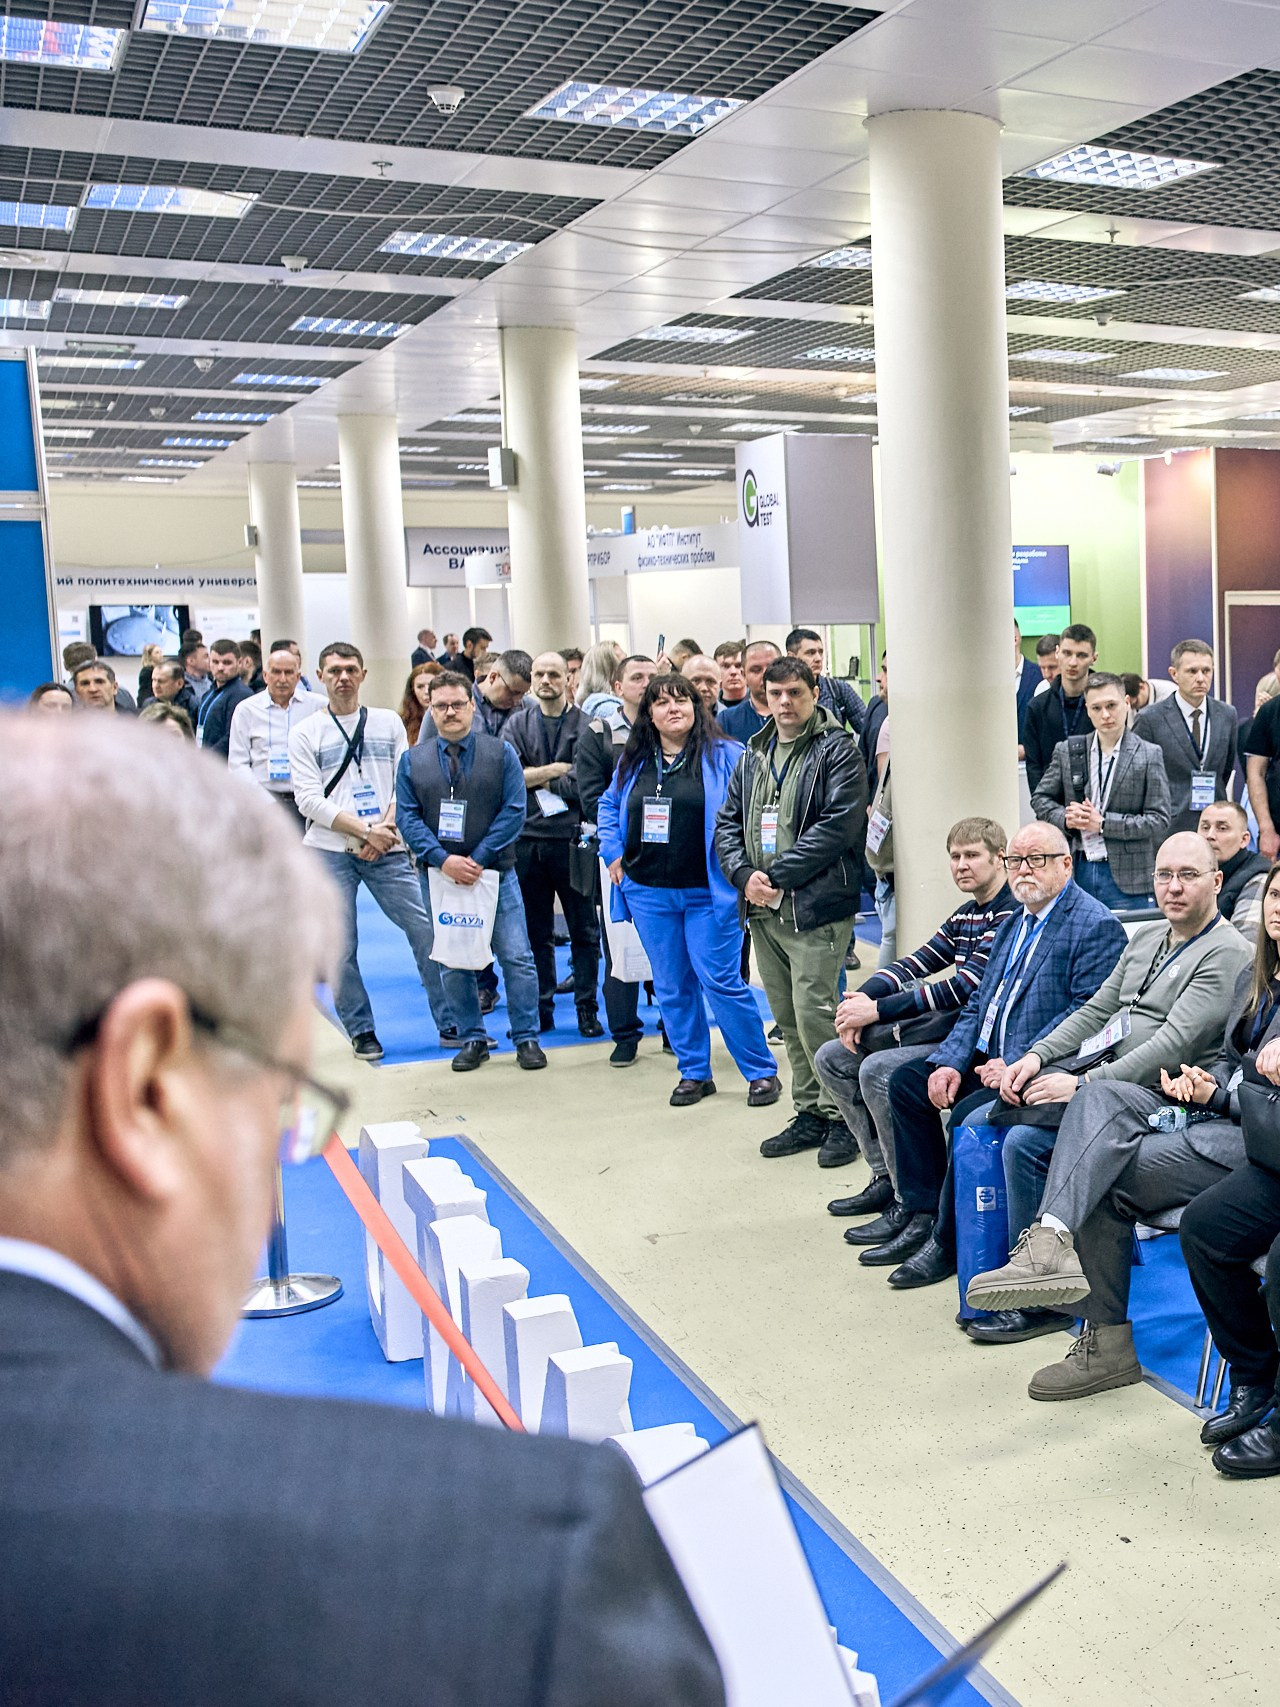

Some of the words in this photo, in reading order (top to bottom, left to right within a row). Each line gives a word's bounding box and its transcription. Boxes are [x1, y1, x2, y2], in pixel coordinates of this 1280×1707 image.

[760, 512, 772, 526] TEST
[677, 531, 701, 548] Институт
[423, 543, 510, 556] Ассоциаци
[588, 551, 611, 566] РПРИБОР
[691, 548, 715, 566] проблем
[57, 576, 74, 586] ий
[78, 576, 195, 586] политехнический
